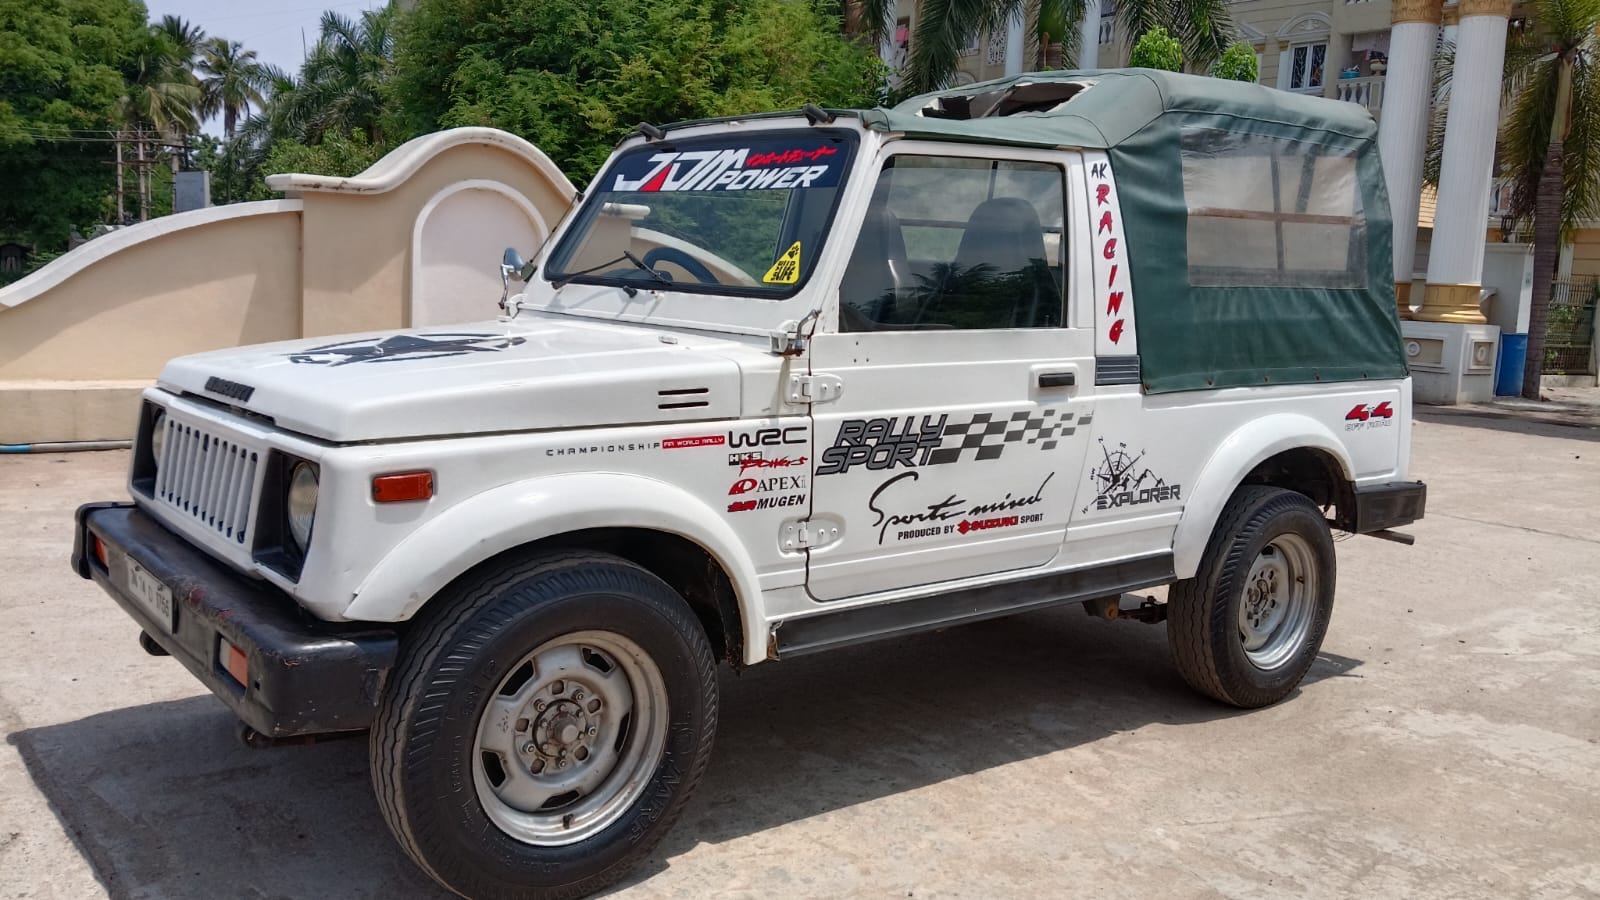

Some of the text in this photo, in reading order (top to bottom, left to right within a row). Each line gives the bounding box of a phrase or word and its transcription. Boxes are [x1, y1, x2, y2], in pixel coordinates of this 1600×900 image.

[710, 165, 829, 191] POWER
[1091, 163, 1107, 178] AK
[1096, 183, 1125, 344] RACING
[728, 426, 807, 448] WRC
[834, 413, 948, 447] RALLY
[545, 442, 660, 456] CHAMPIONSHIP
[814, 438, 943, 476] SPORT
[757, 494, 805, 509] MUGEN
[1097, 485, 1180, 510] EXPLORER
[897, 525, 941, 541] PRODUCED
[943, 524, 955, 534] BY
[1020, 513, 1044, 524] SPORT
